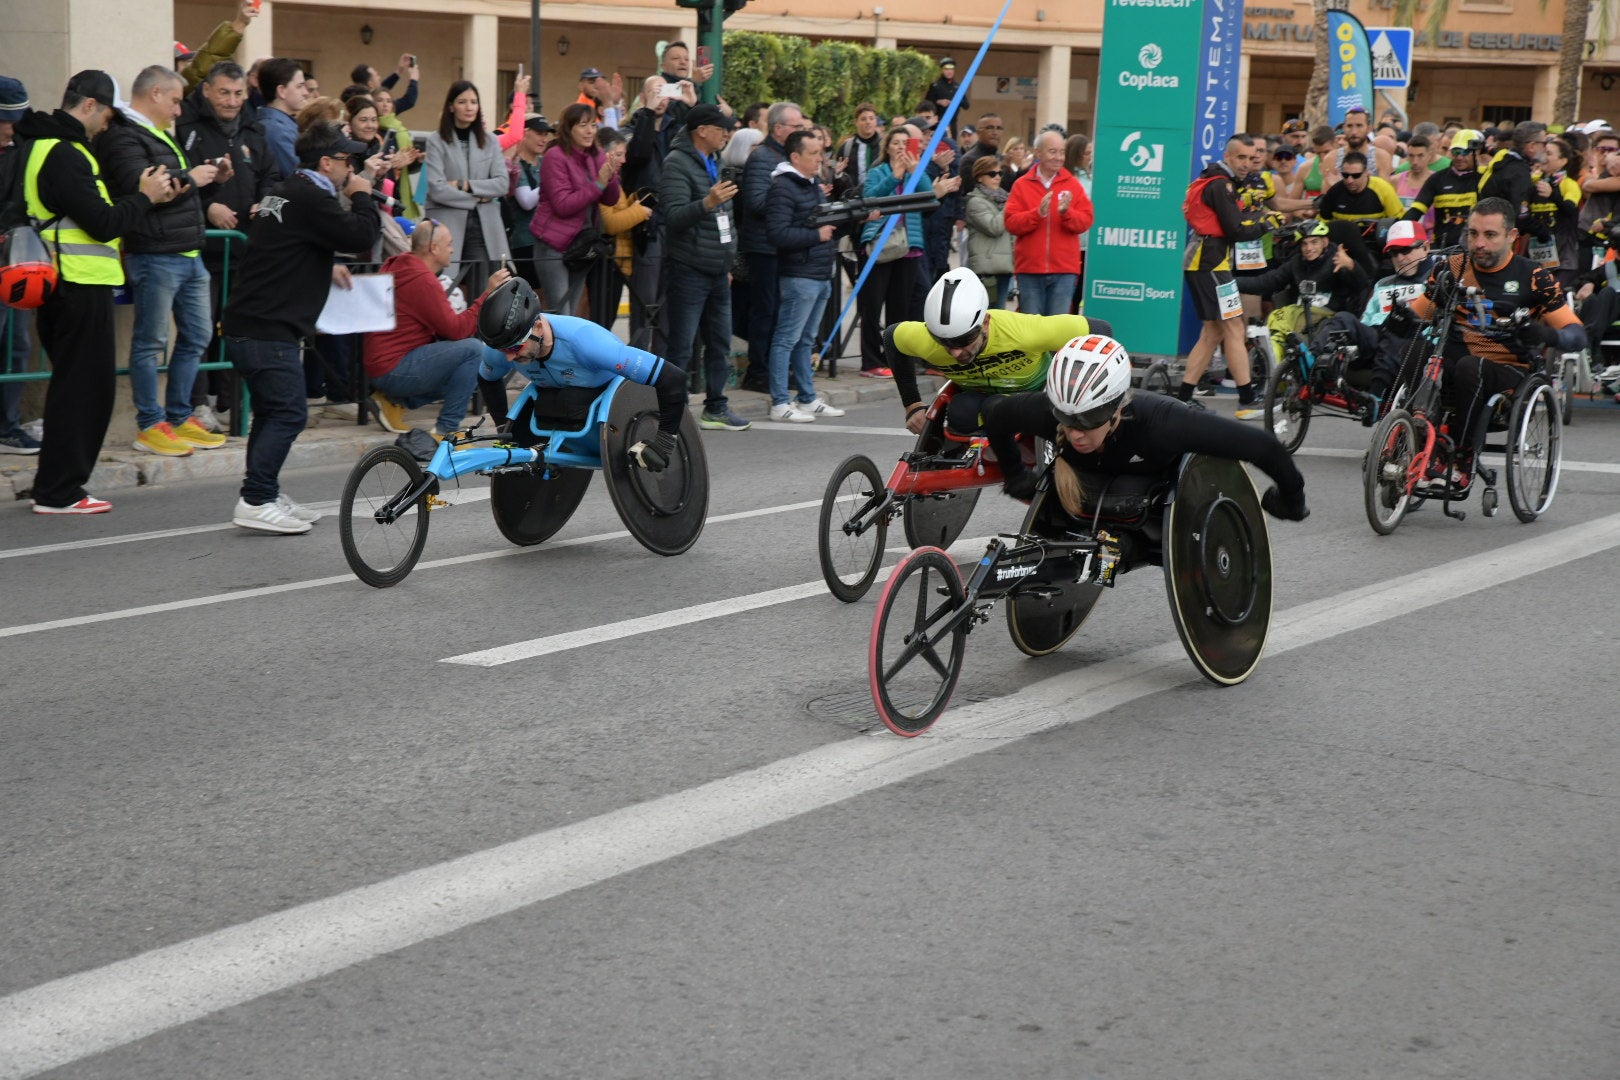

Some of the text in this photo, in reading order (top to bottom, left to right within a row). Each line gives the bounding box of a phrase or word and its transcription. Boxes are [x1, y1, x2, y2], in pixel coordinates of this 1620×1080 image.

[1438, 31, 1464, 49] DE
[1468, 32, 1563, 51] SEGUROS
[1119, 71, 1179, 90] Coplaca
[1104, 227, 1166, 249] MUELLE
[1146, 288, 1175, 300] Sport
